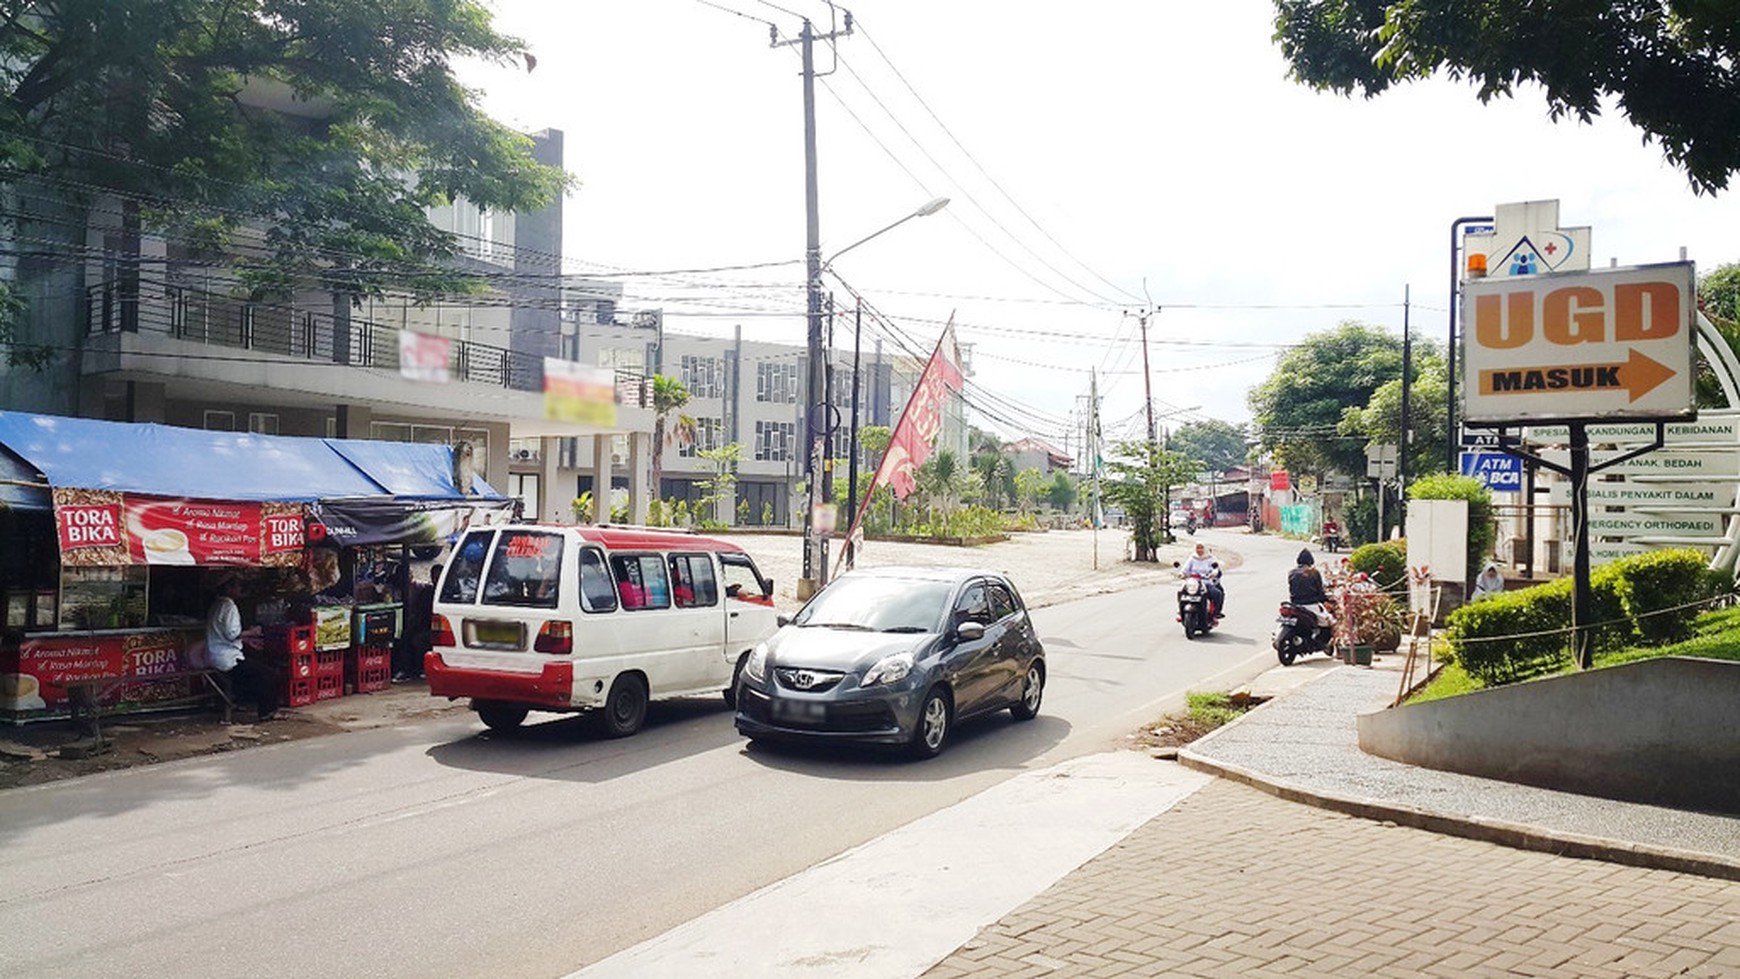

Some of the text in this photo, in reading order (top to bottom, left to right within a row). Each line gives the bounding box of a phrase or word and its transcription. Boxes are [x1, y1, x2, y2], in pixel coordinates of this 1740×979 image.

[1476, 282, 1680, 350] UGD
[1492, 367, 1621, 391] MASUK
[1587, 427, 1654, 436] KANDUNGAN
[1667, 425, 1733, 435] KEBIDANAN
[1481, 458, 1512, 470] ATM
[1664, 459, 1702, 468] BEDAH
[1489, 472, 1519, 484] BCA
[1620, 490, 1674, 499] PENYAKIT
[1675, 490, 1714, 500] DALAM
[62, 509, 113, 526] TORA
[1644, 520, 1714, 531] ORTHOPAEDI
[68, 526, 116, 542] BIKA
[131, 649, 177, 666] TORA
